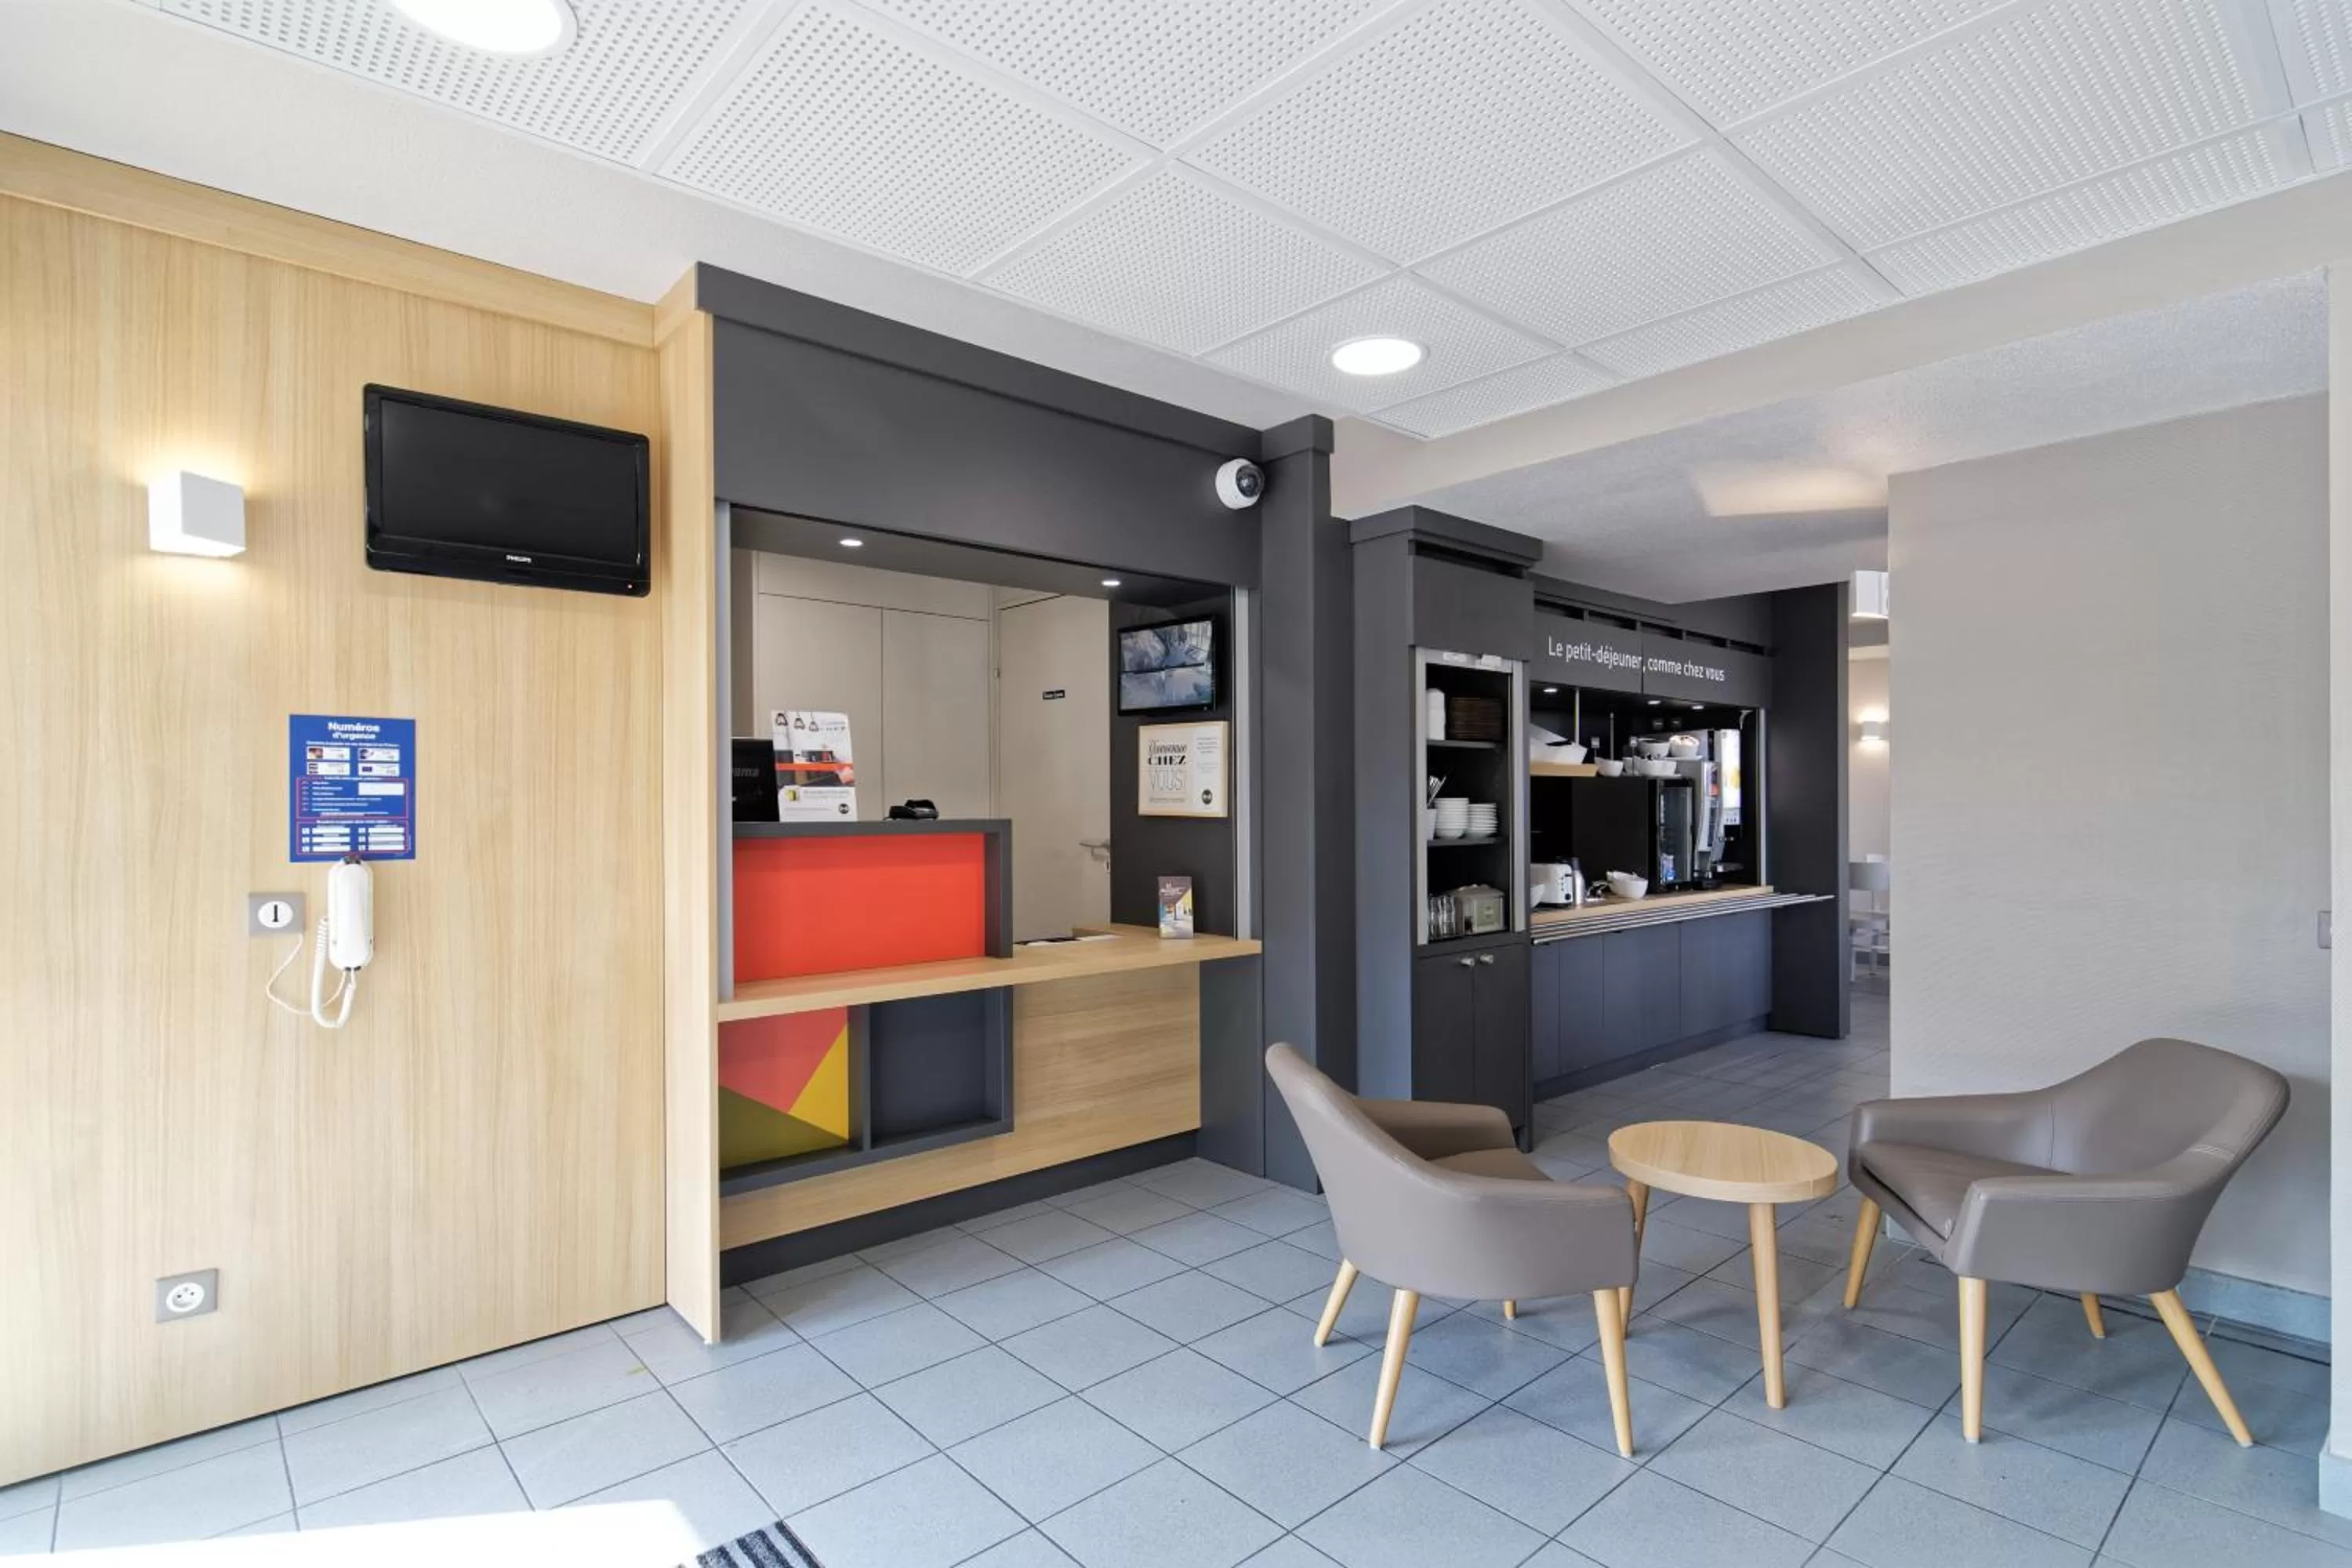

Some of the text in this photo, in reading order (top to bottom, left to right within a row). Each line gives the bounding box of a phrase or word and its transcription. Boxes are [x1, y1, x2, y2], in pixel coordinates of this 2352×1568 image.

[1548, 636, 1563, 657] Le
[1648, 657, 1682, 676] comme
[1683, 660, 1704, 679] chez
[1705, 666, 1726, 682] vous
[328, 722, 380, 733] Numéros
[1148, 755, 1186, 765] CHEZ
